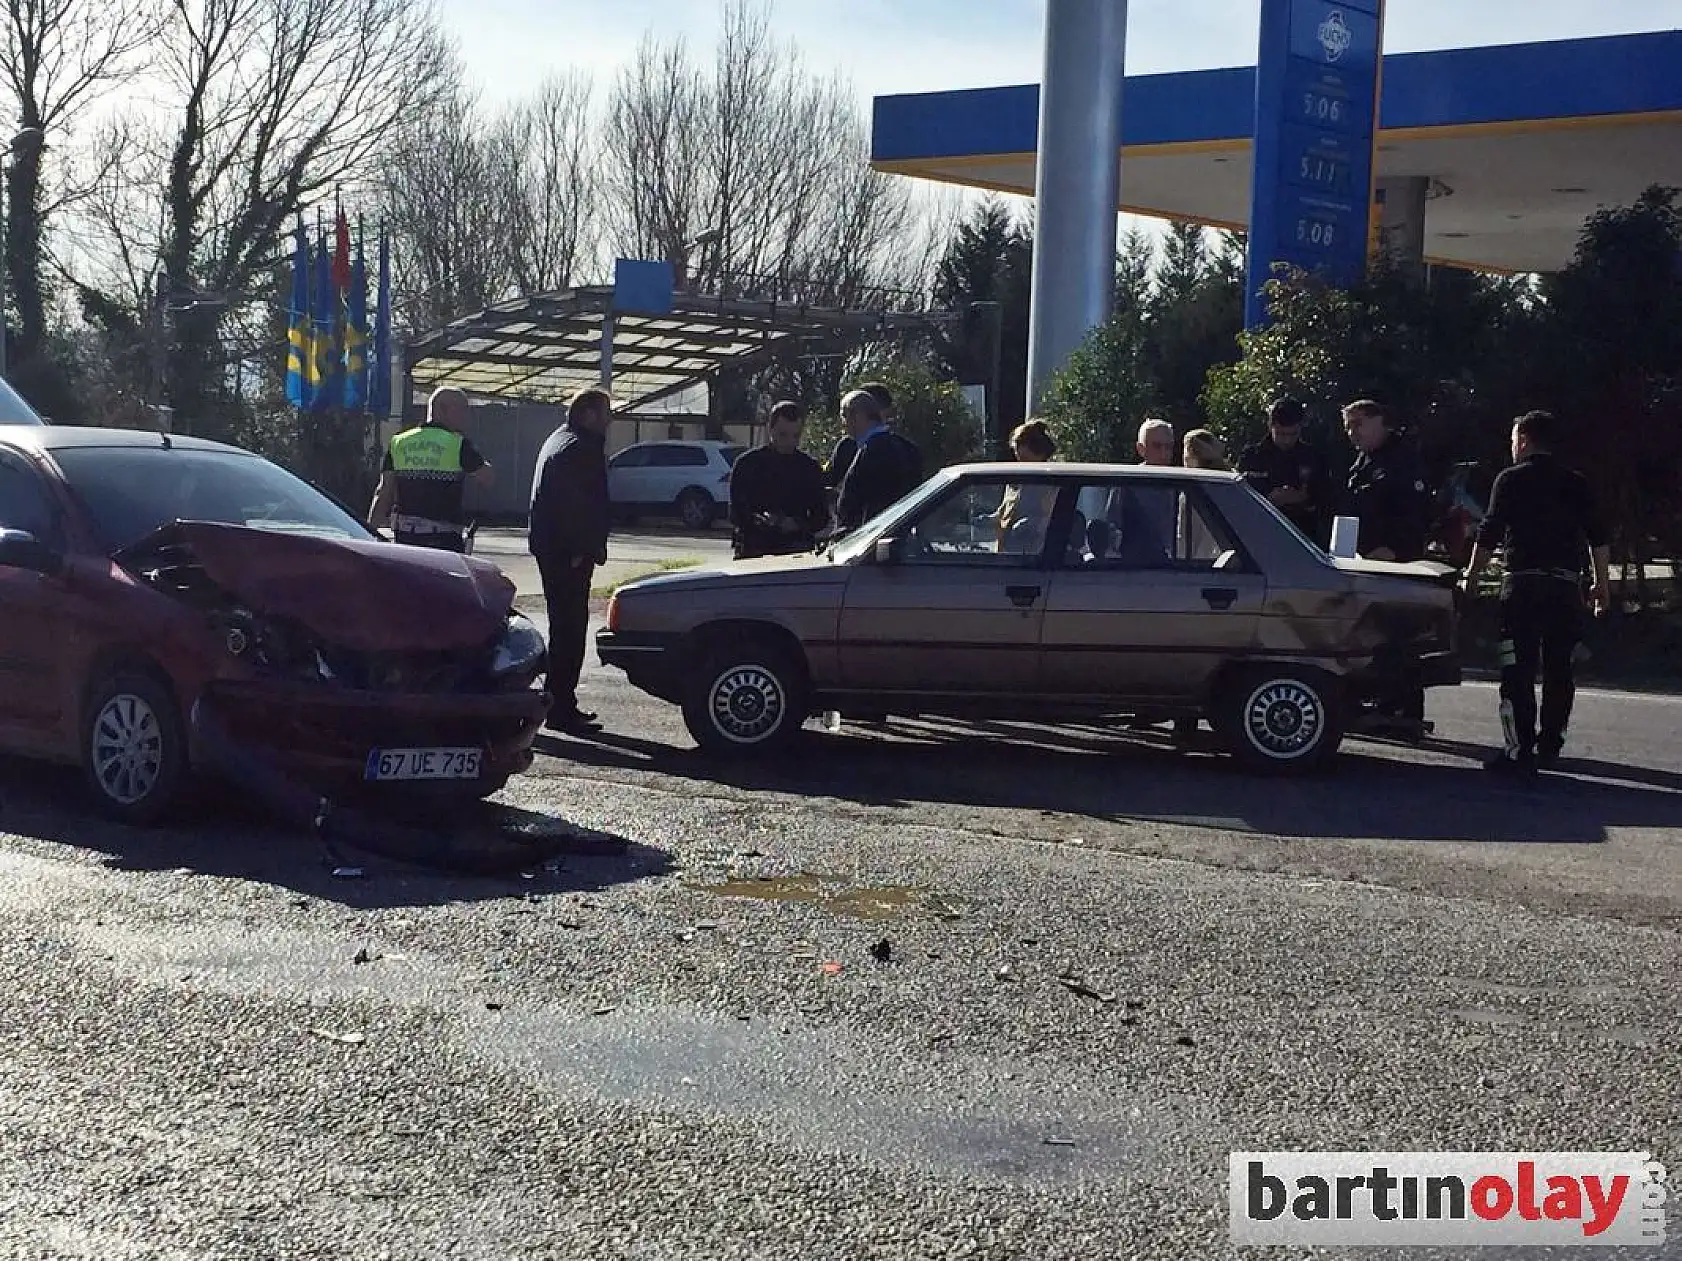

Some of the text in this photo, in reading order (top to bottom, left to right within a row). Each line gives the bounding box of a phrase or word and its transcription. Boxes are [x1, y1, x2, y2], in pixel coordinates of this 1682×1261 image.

[380, 752, 477, 775] 67 UE 735
